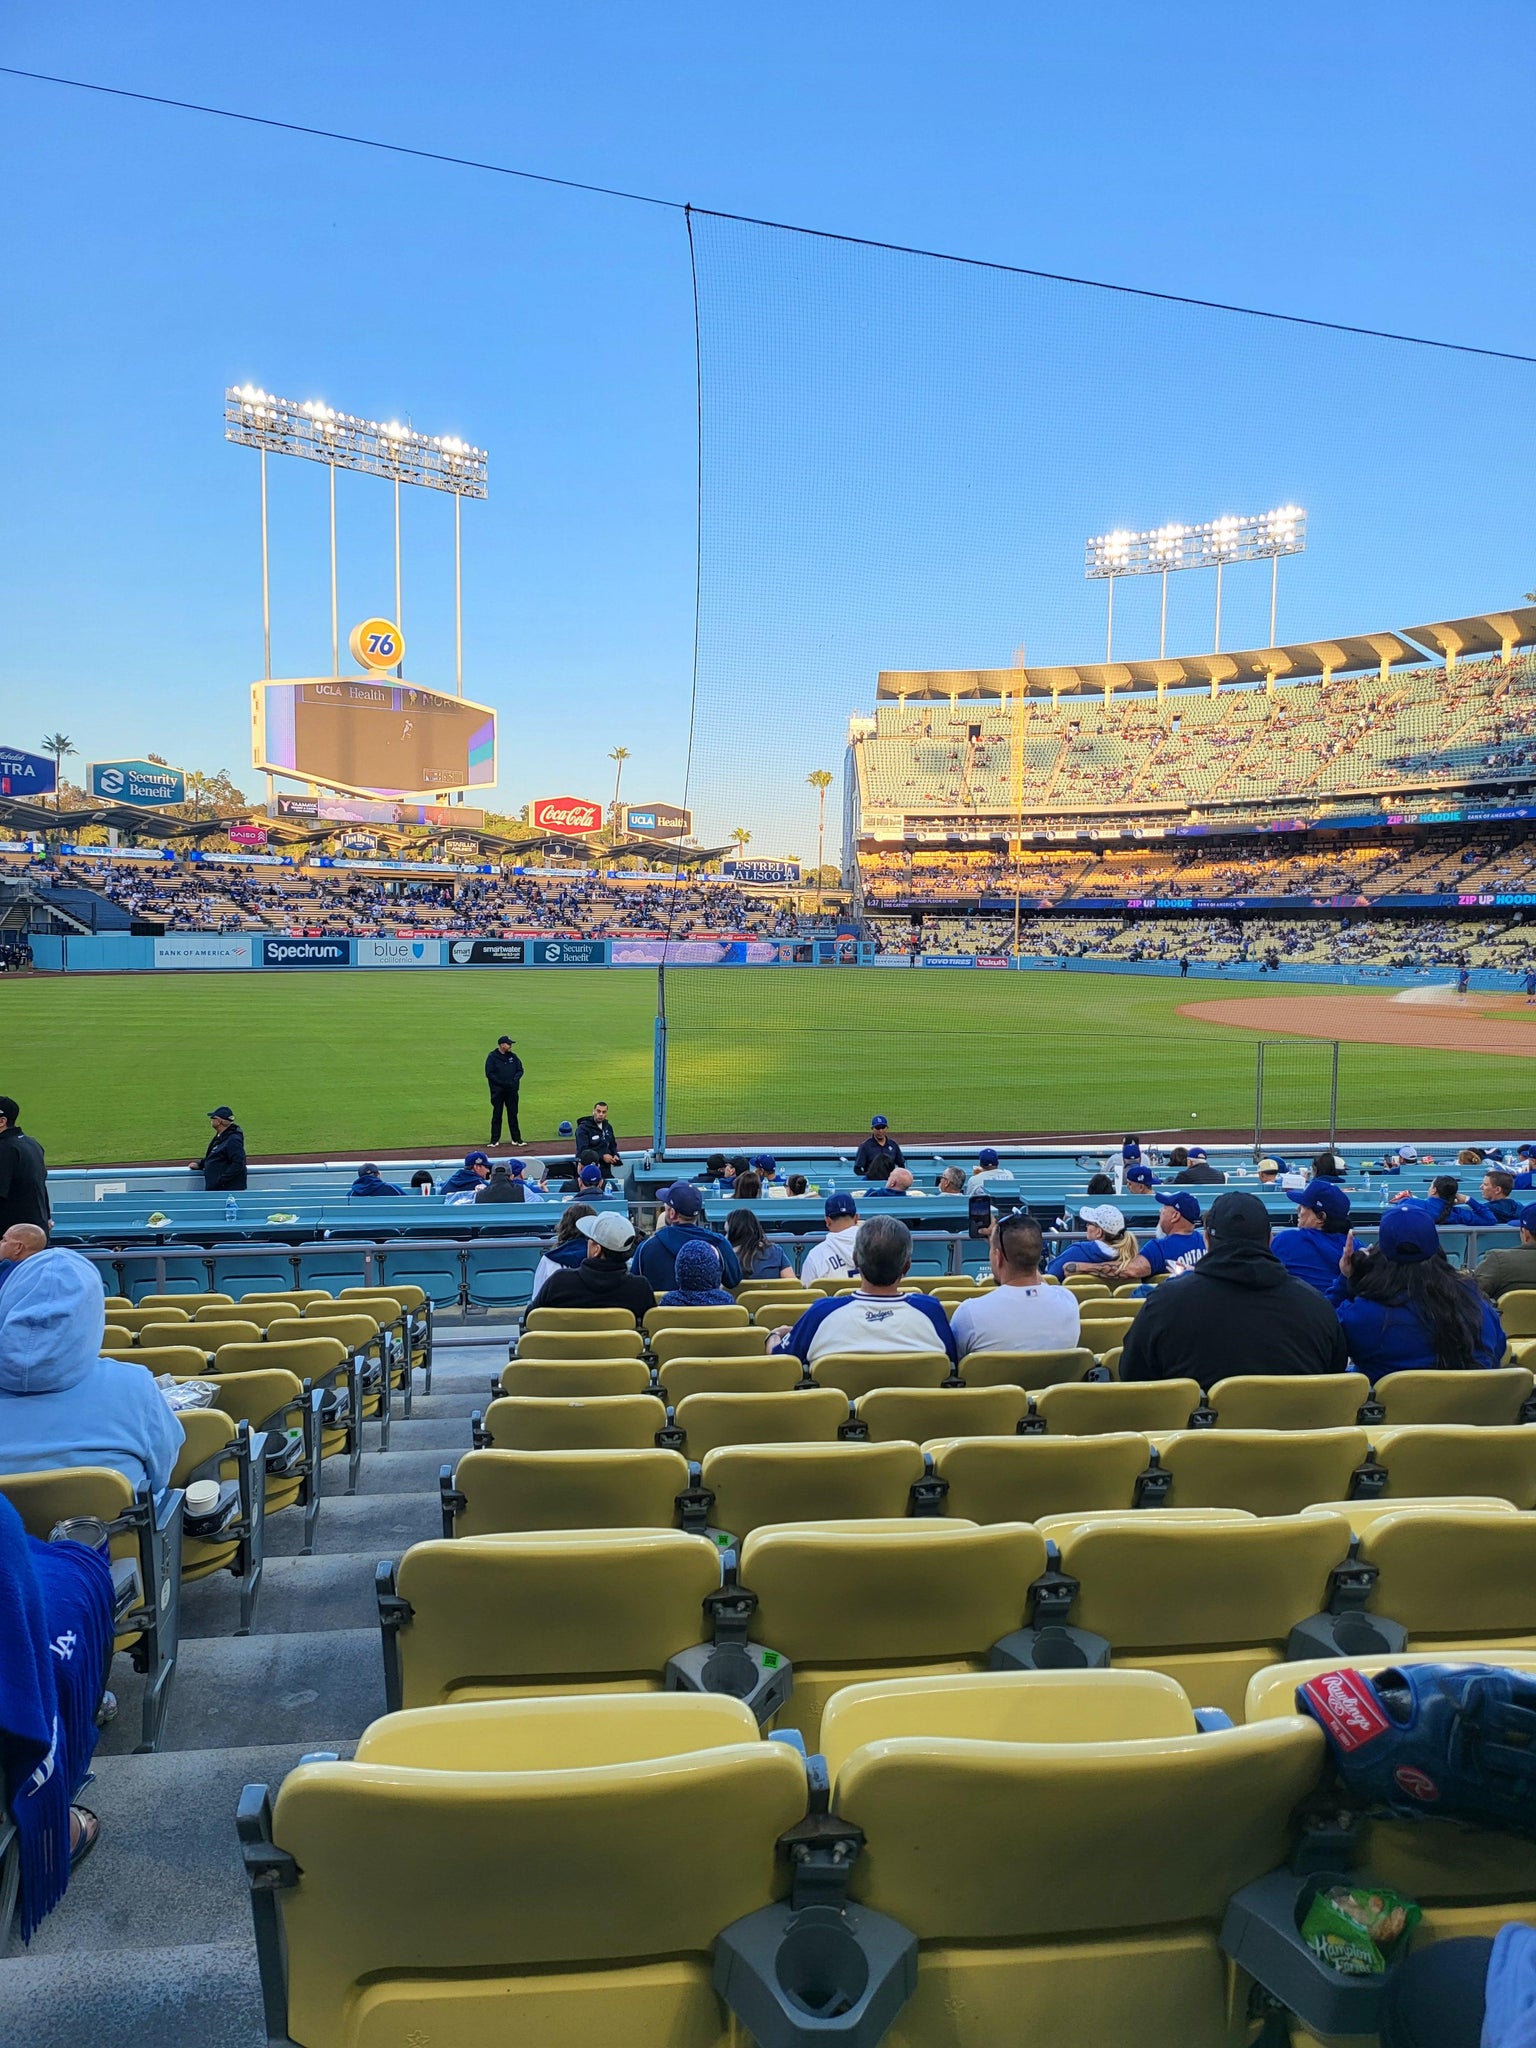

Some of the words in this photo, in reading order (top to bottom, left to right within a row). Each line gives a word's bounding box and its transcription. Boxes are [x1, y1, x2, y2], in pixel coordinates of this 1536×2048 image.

[368, 634, 394, 656] 76
[315, 684, 343, 697] UCLA
[349, 686, 385, 701] Health
[0, 762, 36, 777] TRA
[128, 770, 179, 788] Security
[129, 783, 174, 799] Benefit
[539, 804, 597, 827] Coca-Cola
[631, 816, 654, 826] UCLA
[657, 816, 688, 828] Health
[1387, 815, 1403, 825] ZIP
[1403, 814, 1417, 824] UP
[1419, 811, 1460, 823] HOODIE
[230, 831, 256, 839] DAISO
[344, 834, 357, 847] JIM
[357, 833, 375, 848] BEAM
[731, 870, 781, 881] JALISCO
[1127, 899, 1142, 908] ZIP
[1143, 899, 1155, 908] UP
[1156, 899, 1193, 908] HOODIE
[1458, 895, 1477, 905] ZIP
[1479, 895, 1494, 905] UP
[267, 942, 338, 962] Spectrum
[374, 942, 409, 957] blue
[563, 943, 593, 954] Security
[782, 949, 791, 957] 76
[379, 956, 413, 964] california
[563, 954, 590, 962] Benefit
[865, 1309, 895, 1322] Dodgers
[49, 1630, 77, 1661] LA
[1321, 1676, 1370, 1731] Rawlings
[1306, 1934, 1373, 1964] Hampton
